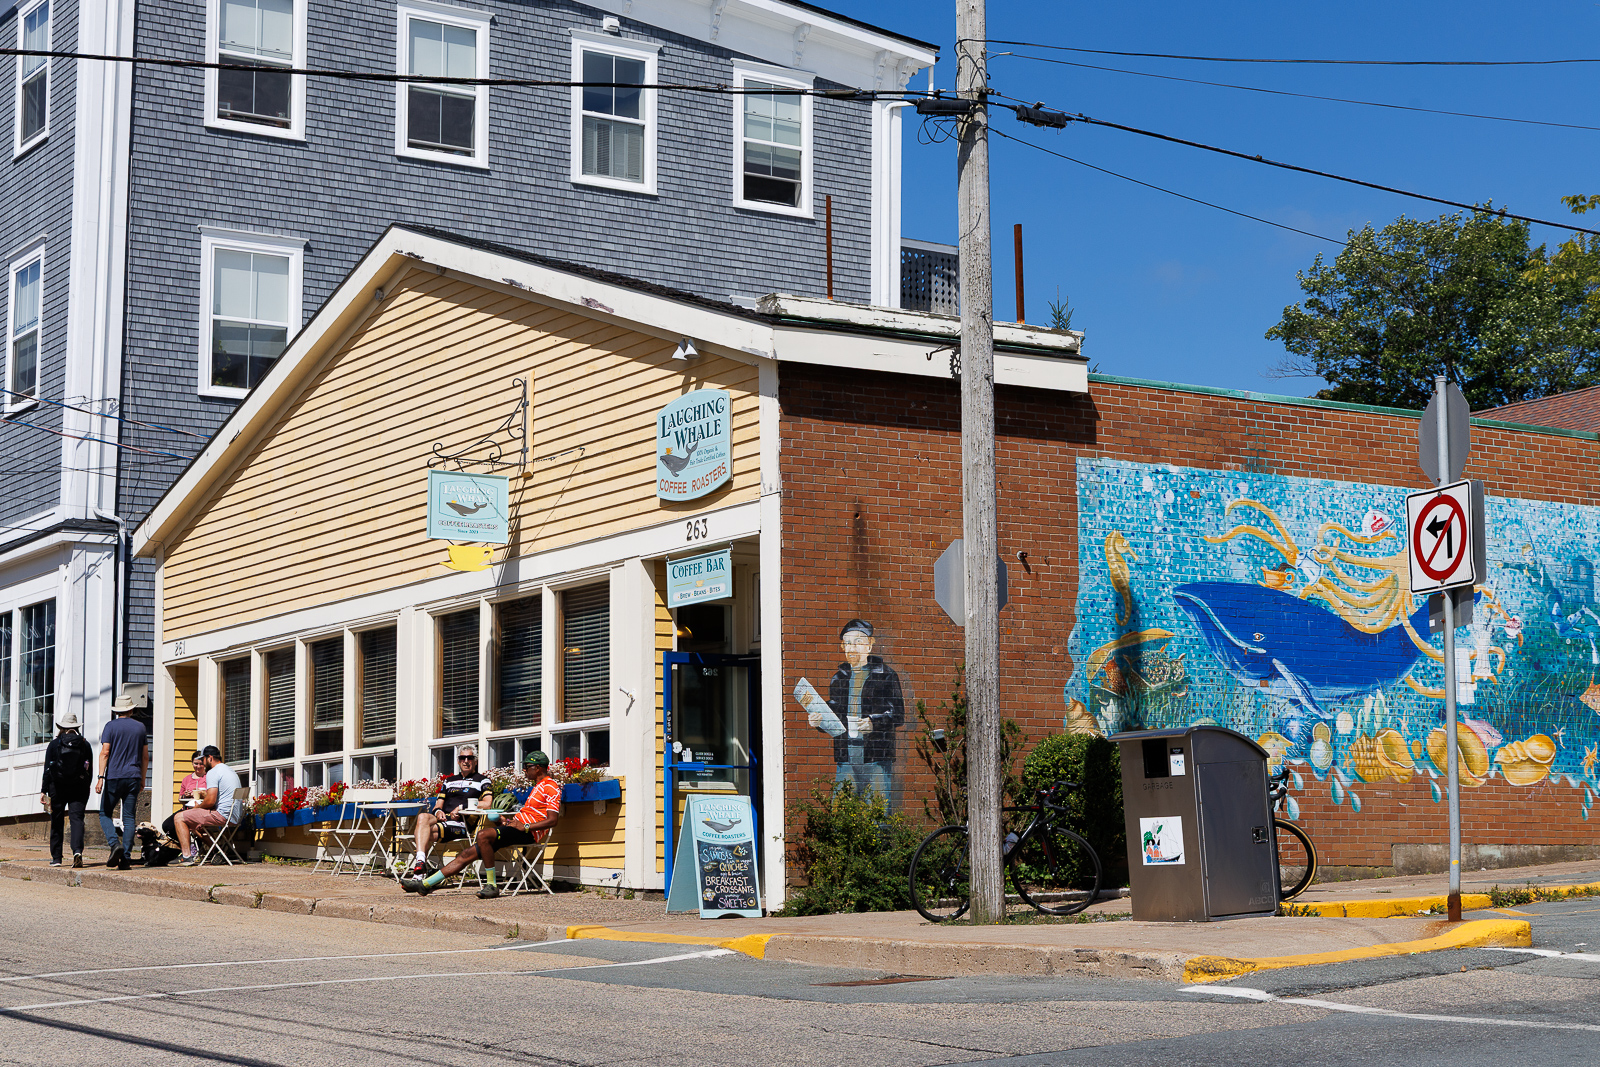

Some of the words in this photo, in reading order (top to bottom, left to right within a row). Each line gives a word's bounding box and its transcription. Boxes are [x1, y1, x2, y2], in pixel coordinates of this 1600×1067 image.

[660, 397, 725, 438] LAUGHING
[674, 419, 722, 450] WHALE
[660, 479, 687, 494] COFFEE
[692, 462, 727, 493] ROASTERS
[443, 485, 494, 495] LAUGHING
[456, 494, 494, 503] WHALE
[686, 518, 707, 541] 263
[672, 562, 703, 579] COFFEE
[706, 557, 725, 573] BAR
[680, 592, 691, 600] BREW
[694, 589, 706, 597] BEANS
[709, 586, 721, 594] BITES
[174, 640, 186, 656] 261
[1143, 781, 1173, 790] GARBAGE
[699, 803, 743, 813] LAUGHING
[708, 811, 740, 820] WHALE
[702, 831, 720, 839] COFFEE
[720, 862, 748, 871] QUICHES
[705, 876, 748, 886] BREAKFAST
[715, 886, 755, 894] CROISSANTS
[718, 897, 747, 909] SWEETS
